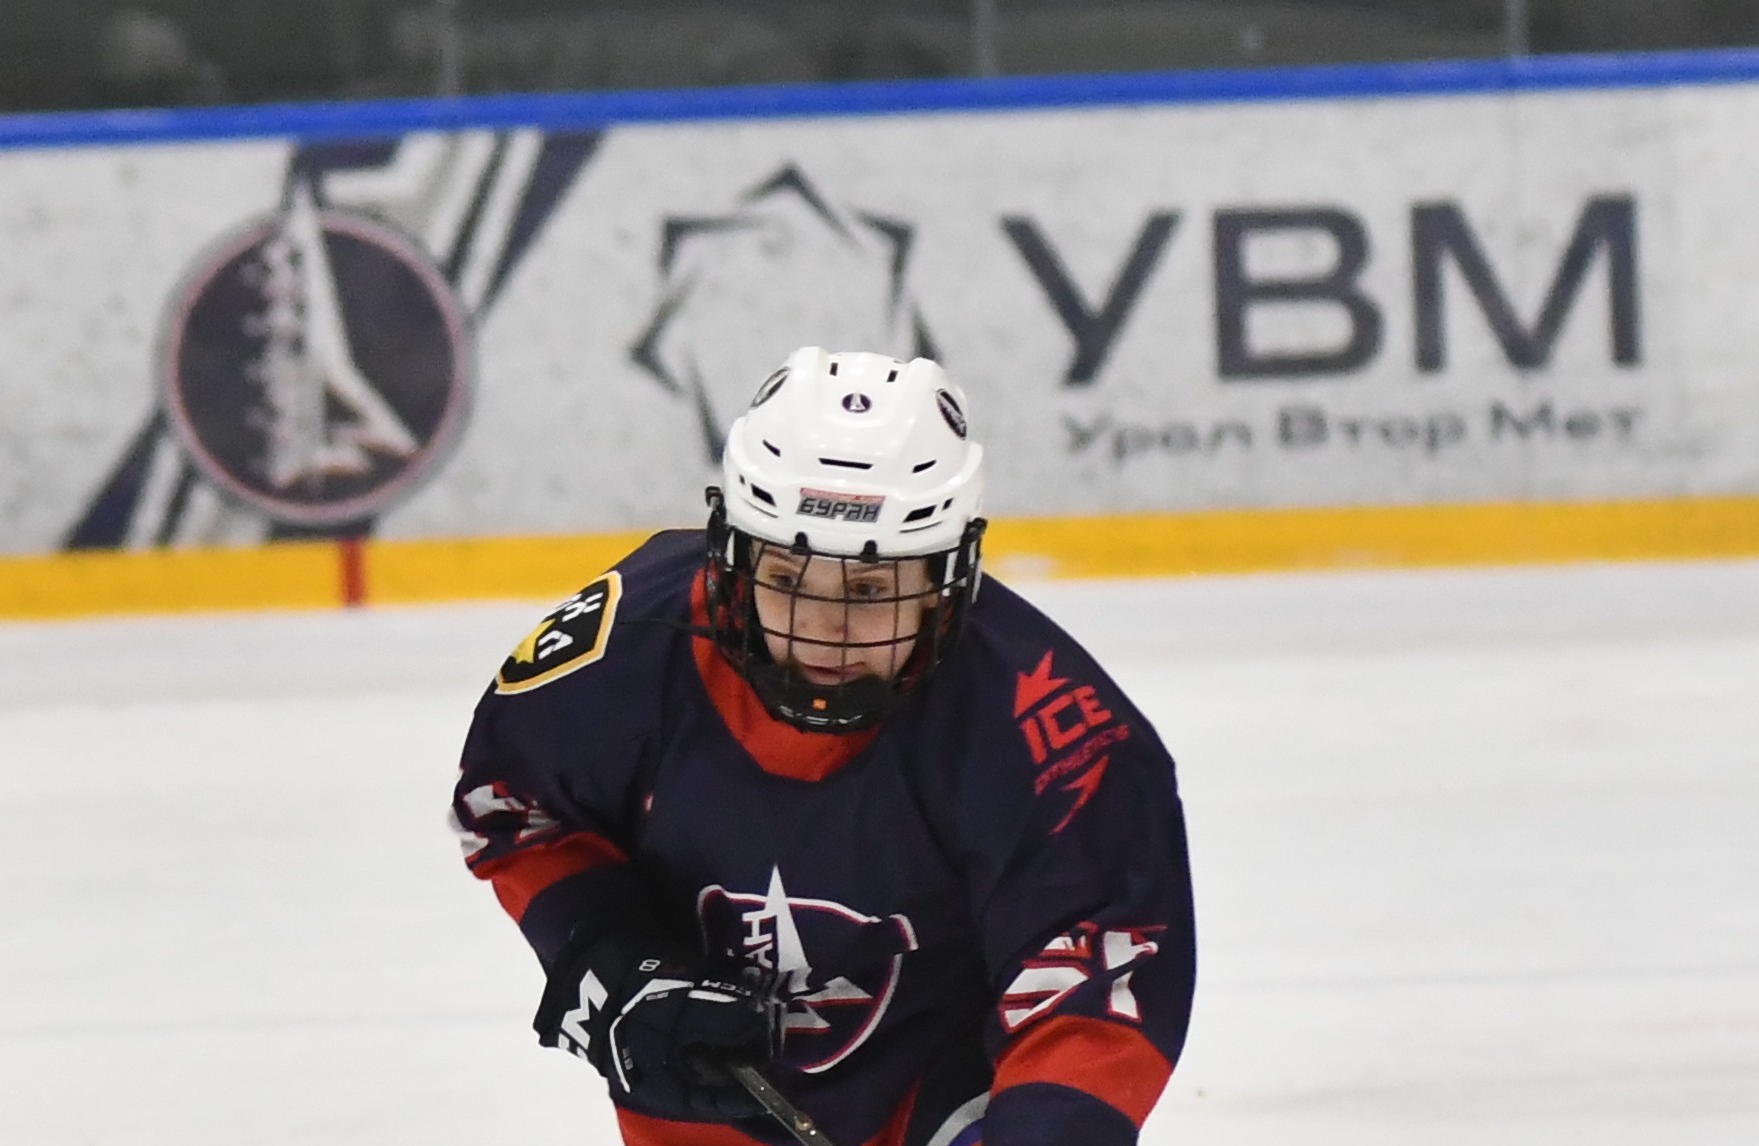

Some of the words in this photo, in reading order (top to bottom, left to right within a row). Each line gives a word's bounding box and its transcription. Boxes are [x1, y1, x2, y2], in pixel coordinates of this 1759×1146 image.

[998, 190, 1643, 390] УВМ
[1061, 410, 1255, 464] Урал
[1275, 403, 1467, 457] Втор
[1489, 398, 1643, 441] Мет
[1020, 684, 1112, 764] ICE
